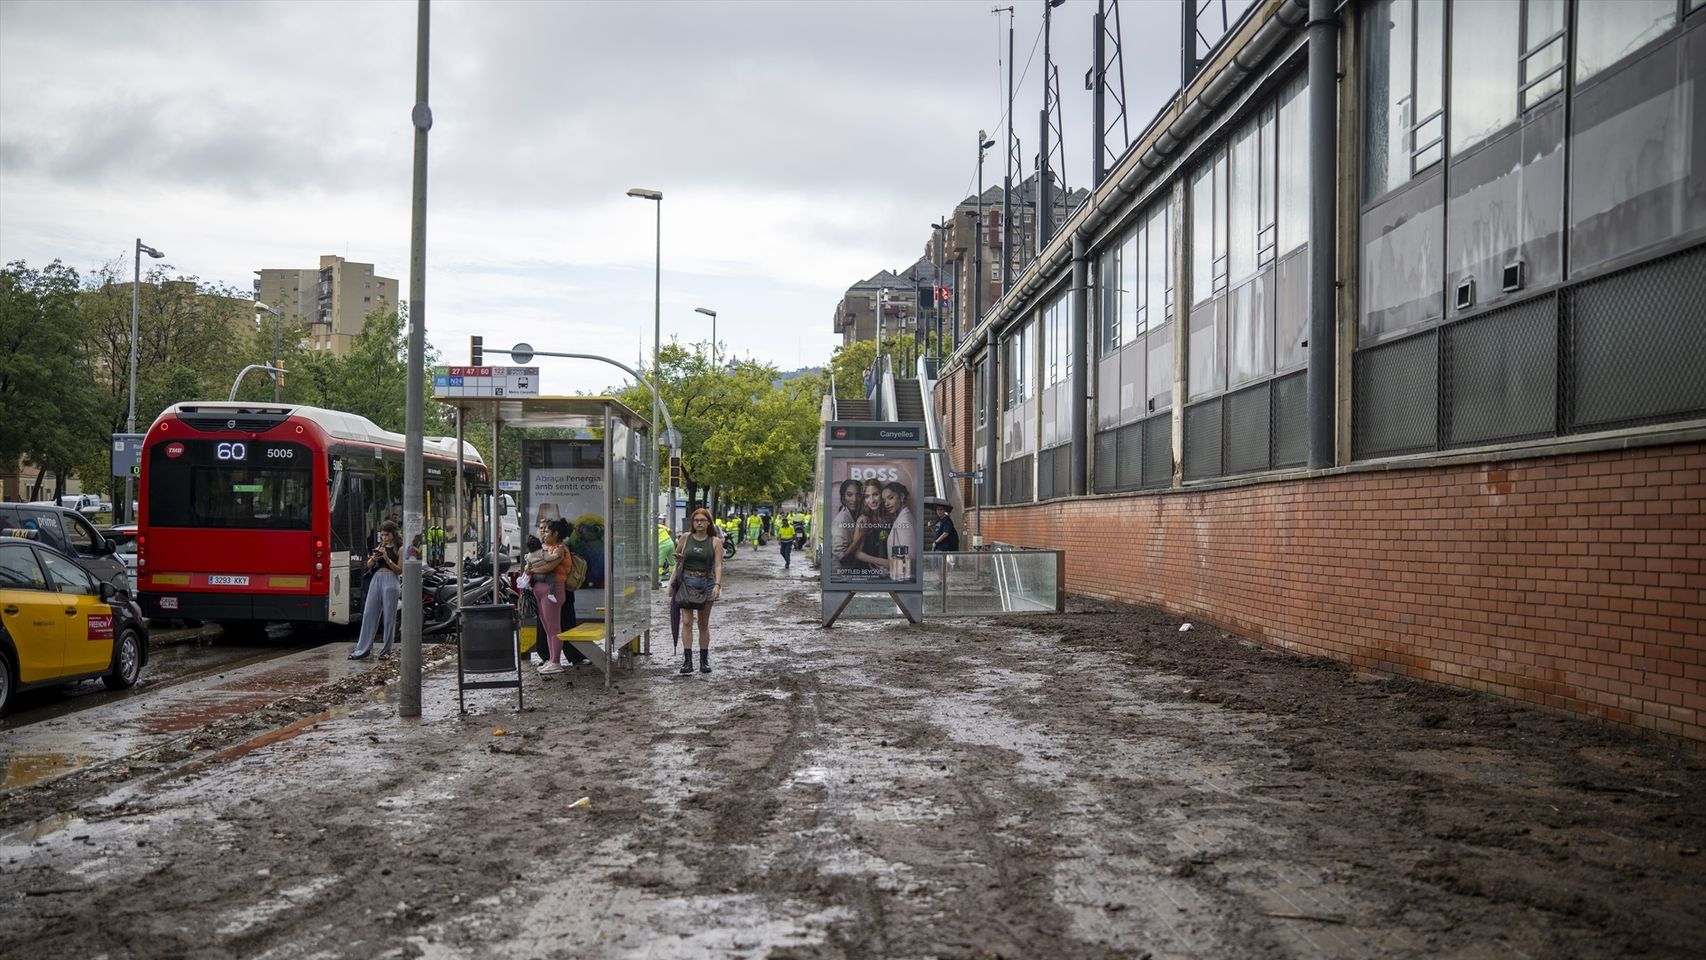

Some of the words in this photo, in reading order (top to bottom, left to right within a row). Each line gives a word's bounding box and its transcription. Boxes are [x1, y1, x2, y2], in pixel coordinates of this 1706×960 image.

[879, 430, 914, 439] Canyelles
[217, 443, 246, 460] 60
[267, 448, 294, 458] 5005
[535, 475, 564, 483] Abraça
[566, 475, 601, 484] l'energia
[850, 467, 898, 482] BOSS
[37, 514, 57, 529] prime
[11, 528, 29, 538] TAXI
[215, 576, 231, 584] 3293
